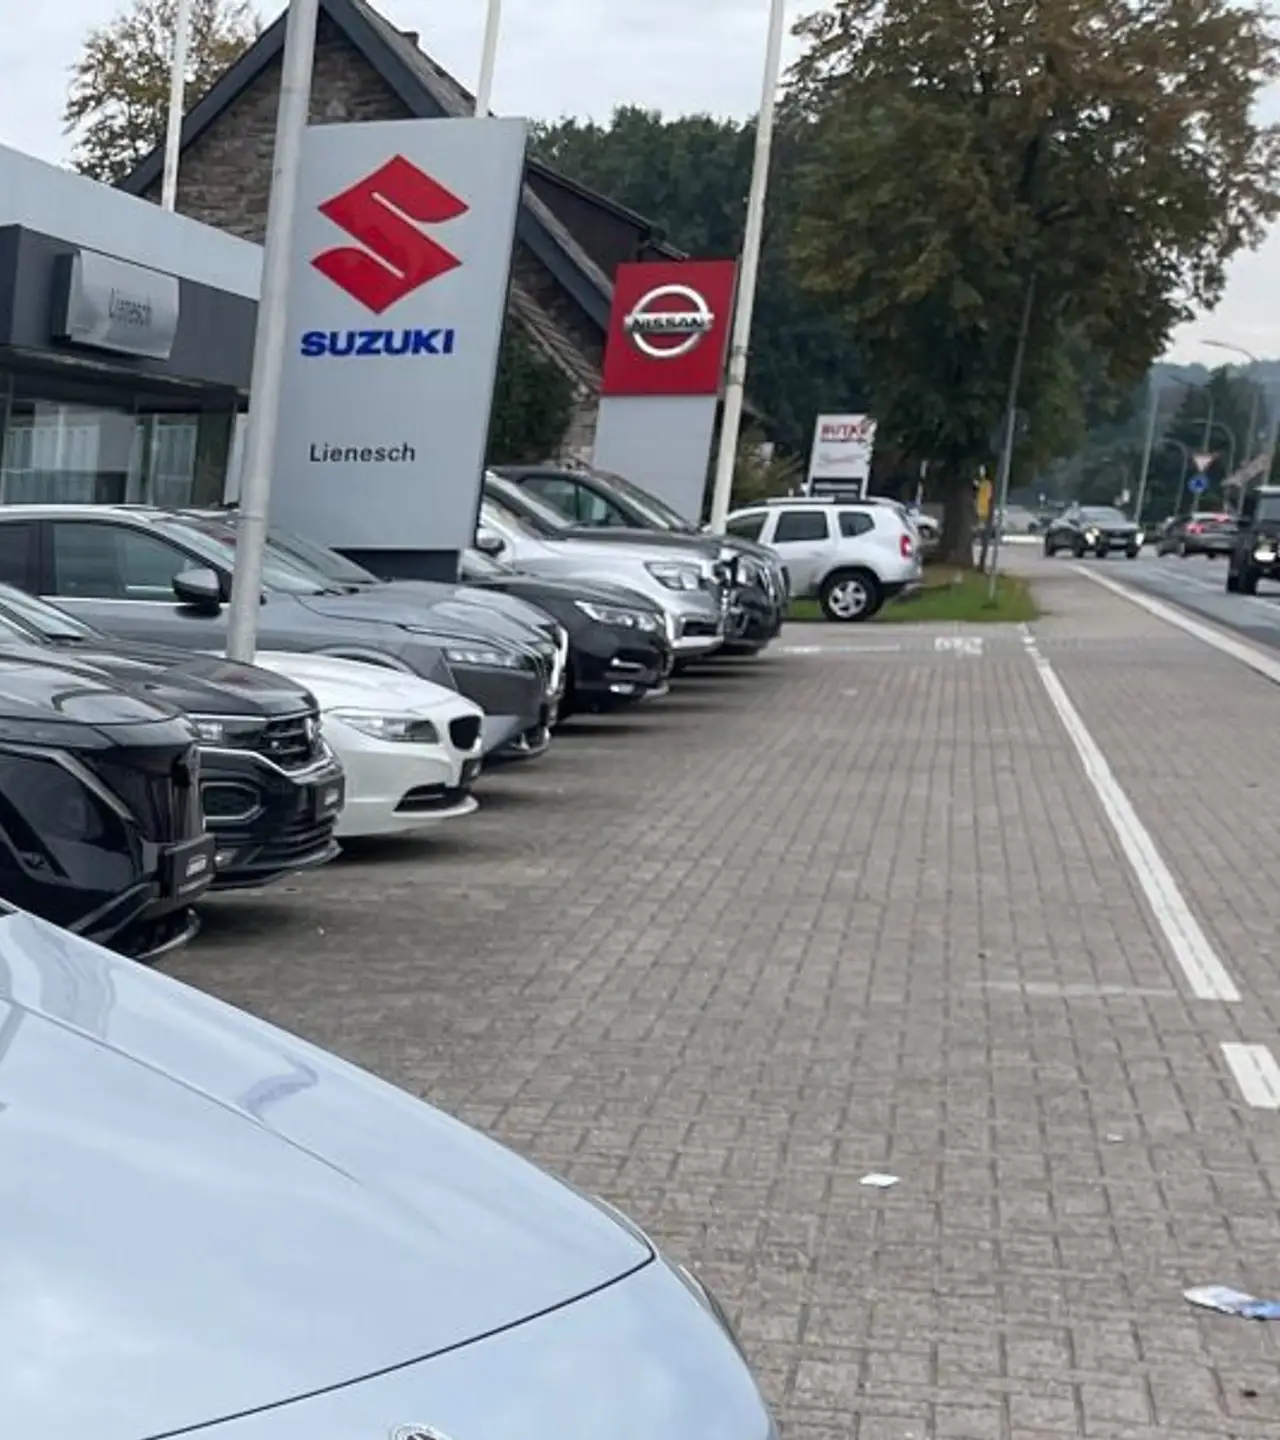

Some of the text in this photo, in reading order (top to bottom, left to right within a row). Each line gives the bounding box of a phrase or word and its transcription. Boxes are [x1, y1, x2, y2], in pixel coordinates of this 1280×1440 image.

[633, 317, 705, 329] NISSAN
[300, 328, 455, 357] SUZUKI
[309, 442, 416, 462] Lienesch
